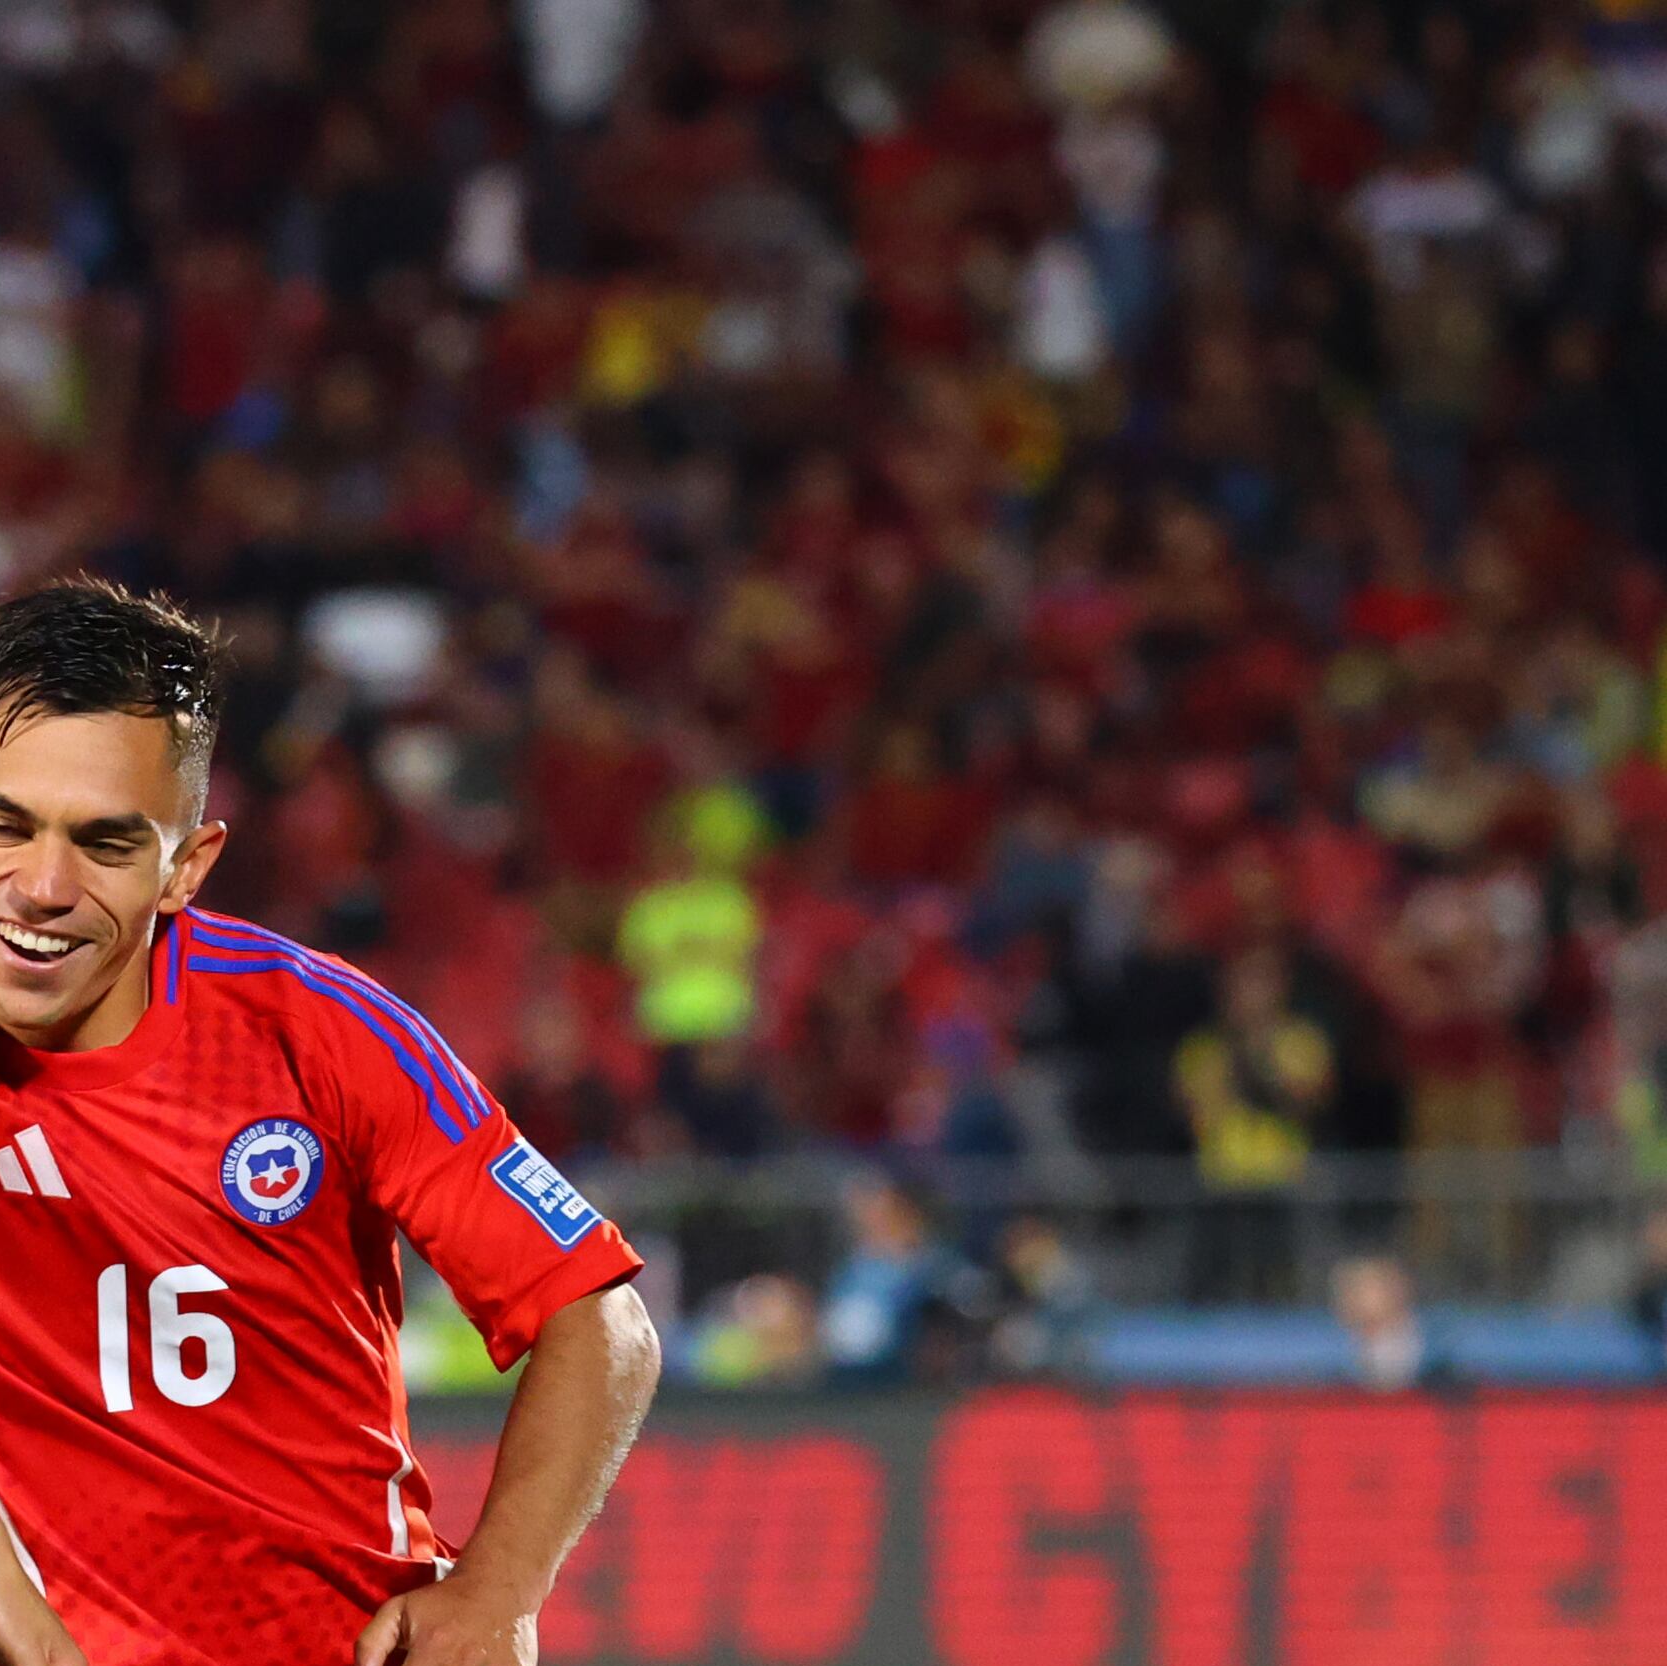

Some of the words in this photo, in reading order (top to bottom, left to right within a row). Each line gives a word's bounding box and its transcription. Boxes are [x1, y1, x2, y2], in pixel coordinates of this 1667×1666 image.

[222, 1124, 267, 1185] FEDERACION
[275, 1122, 289, 1134] DE
[293, 1127, 321, 1163] FUTBOL
[521, 1165, 562, 1198] UNITE
[258, 1210, 272, 1223] DE
[278, 1196, 308, 1221] CHILE
[97, 1263, 237, 1413] 16
